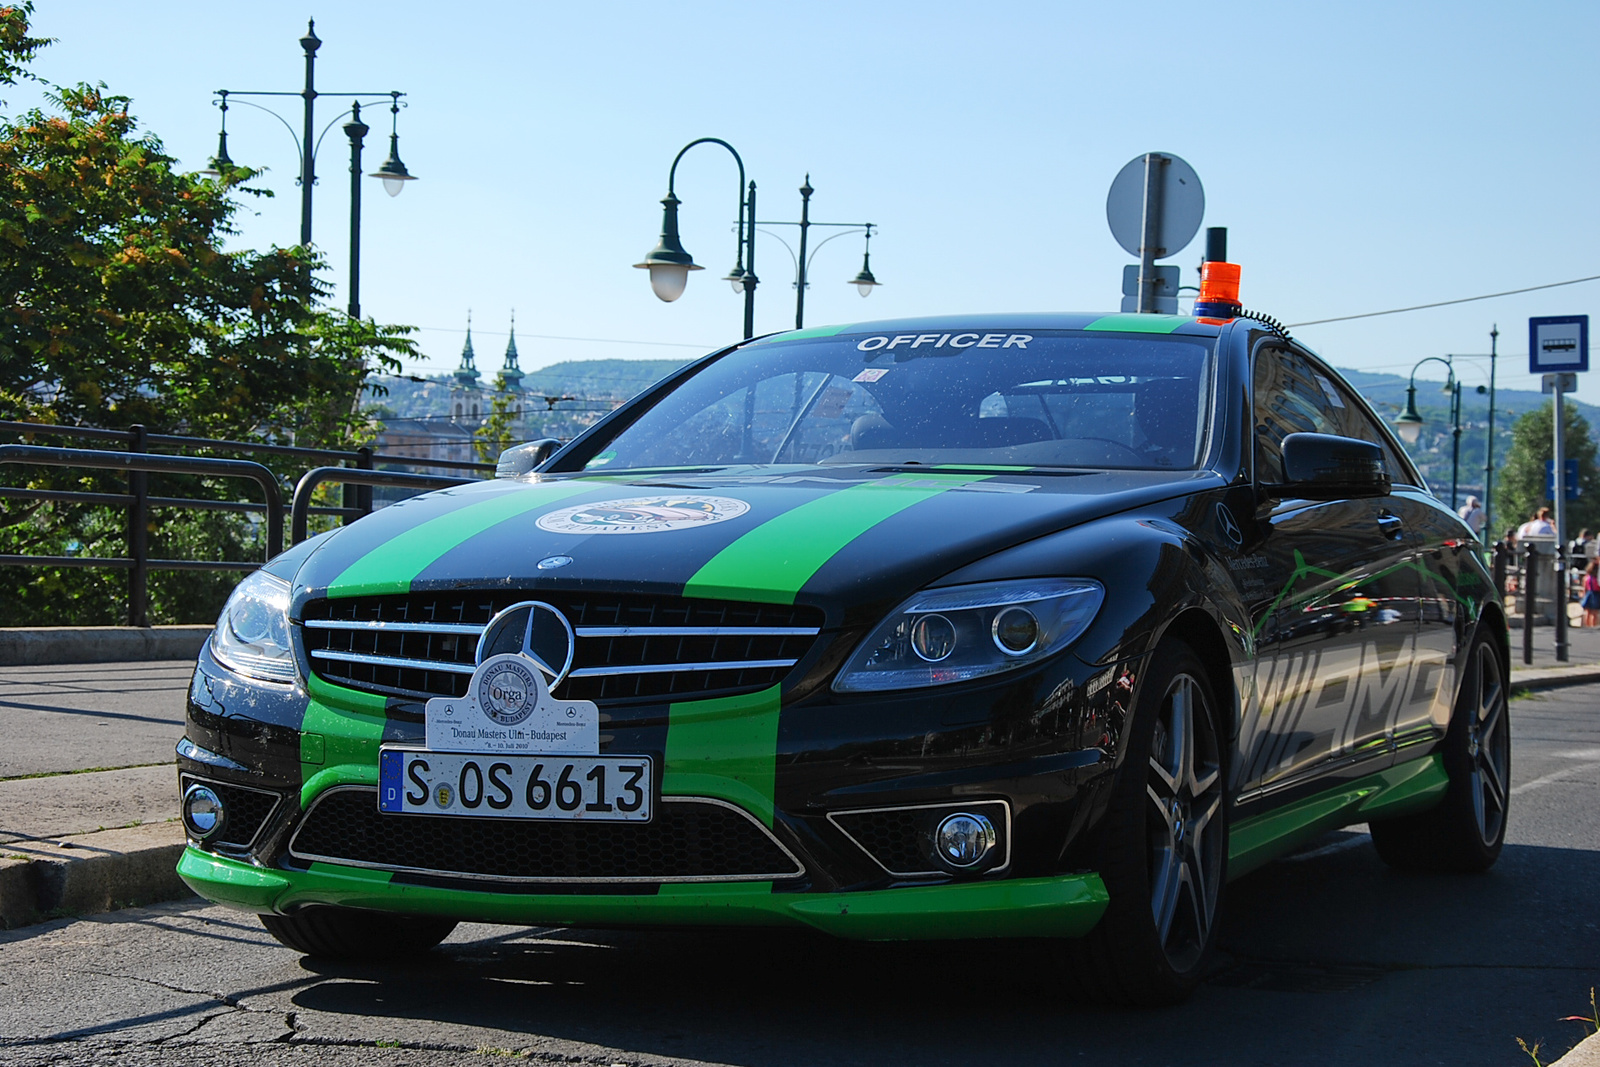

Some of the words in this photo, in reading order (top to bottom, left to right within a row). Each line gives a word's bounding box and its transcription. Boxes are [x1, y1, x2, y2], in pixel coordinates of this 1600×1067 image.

[857, 333, 1034, 351] OFFICER
[483, 664, 503, 686] DONAU
[505, 663, 533, 687] MASTERS
[493, 687, 522, 703] Orga
[500, 702, 532, 722] BUDAPEST
[452, 727, 476, 739] Donau
[478, 728, 507, 739] Masters
[387, 787, 396, 801] D
[406, 759, 431, 806] S
[459, 761, 513, 810] OS
[526, 764, 644, 812] 6613
